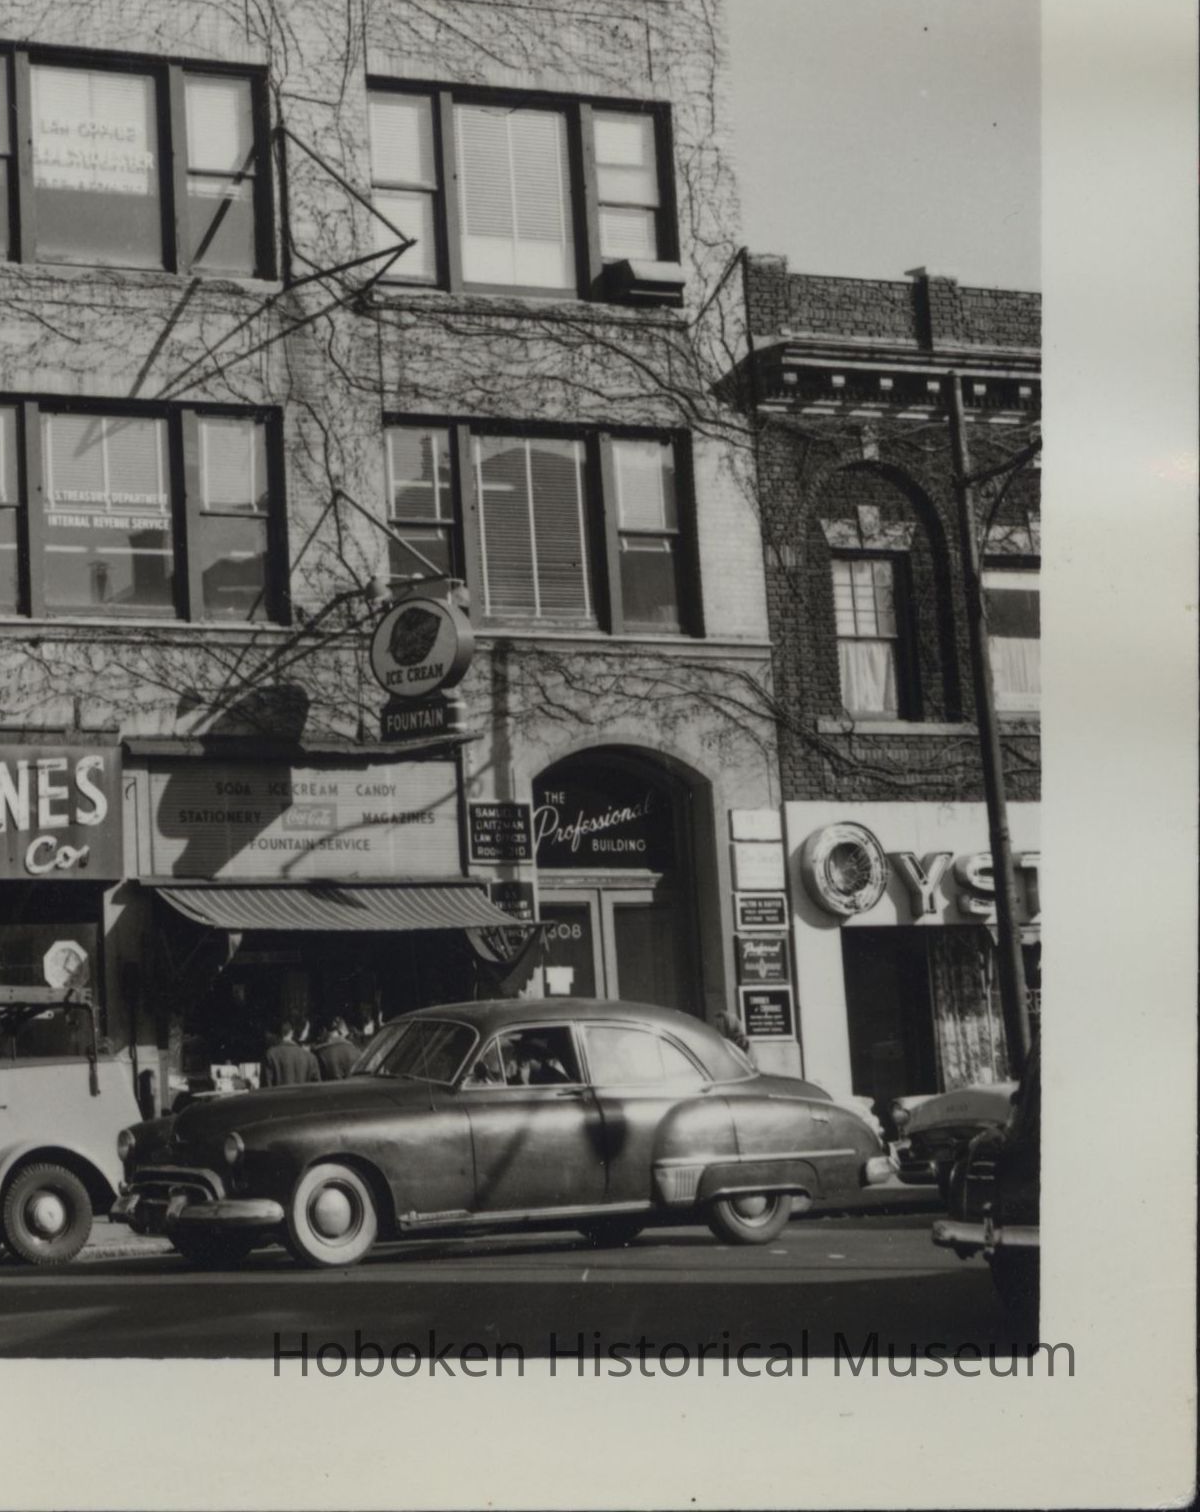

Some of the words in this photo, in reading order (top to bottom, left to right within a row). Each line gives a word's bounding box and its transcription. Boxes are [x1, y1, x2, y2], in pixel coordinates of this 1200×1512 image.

[131, 517, 169, 530] SERVICE
[386, 669, 403, 686] ICE
[406, 662, 444, 684] CREAM
[386, 707, 445, 733] FOUNTAIN
[215, 782, 252, 796] SODA
[269, 782, 291, 796] ICE
[292, 782, 339, 797] CREAM
[355, 783, 398, 797] CANDY
[543, 791, 566, 805] THE
[179, 810, 262, 824] STATIONERY
[361, 810, 436, 825] MAGAZINES
[532, 789, 654, 853] Professional
[250, 837, 315, 851] FOUNTAIN
[318, 838, 371, 851] SERVICE
[591, 838, 647, 852] BUILDING
